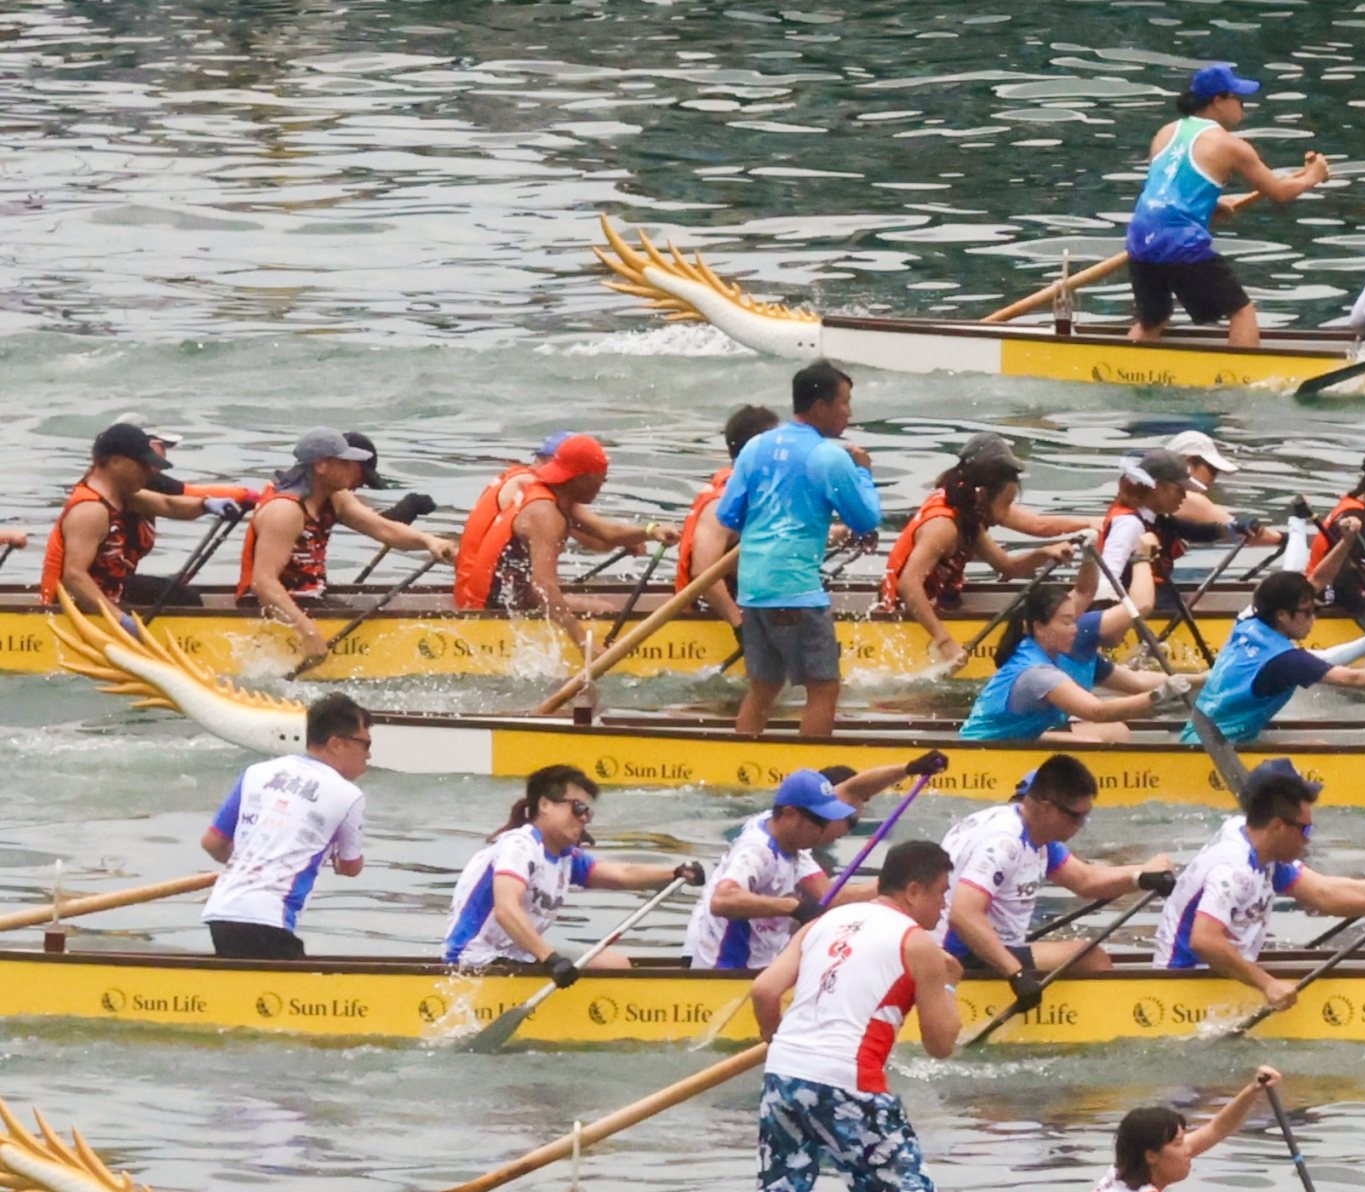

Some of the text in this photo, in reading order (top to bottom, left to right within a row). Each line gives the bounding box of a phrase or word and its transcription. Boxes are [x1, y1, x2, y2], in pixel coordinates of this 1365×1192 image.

[1117, 367, 1145, 382] Sun
[8, 638, 42, 651] Life
[177, 639, 201, 654] ife
[669, 641, 706, 659] Life
[625, 764, 692, 780] Sun Life
[768, 768, 789, 783] Su
[1127, 772, 1159, 788] Life
[962, 772, 996, 789] Life
[132, 996, 206, 1012] Sun Life
[289, 1000, 368, 1017] Sun Life
[625, 1004, 713, 1022] Sun Life
[1036, 1005, 1077, 1024] Life
[1172, 1006, 1206, 1022] Su
